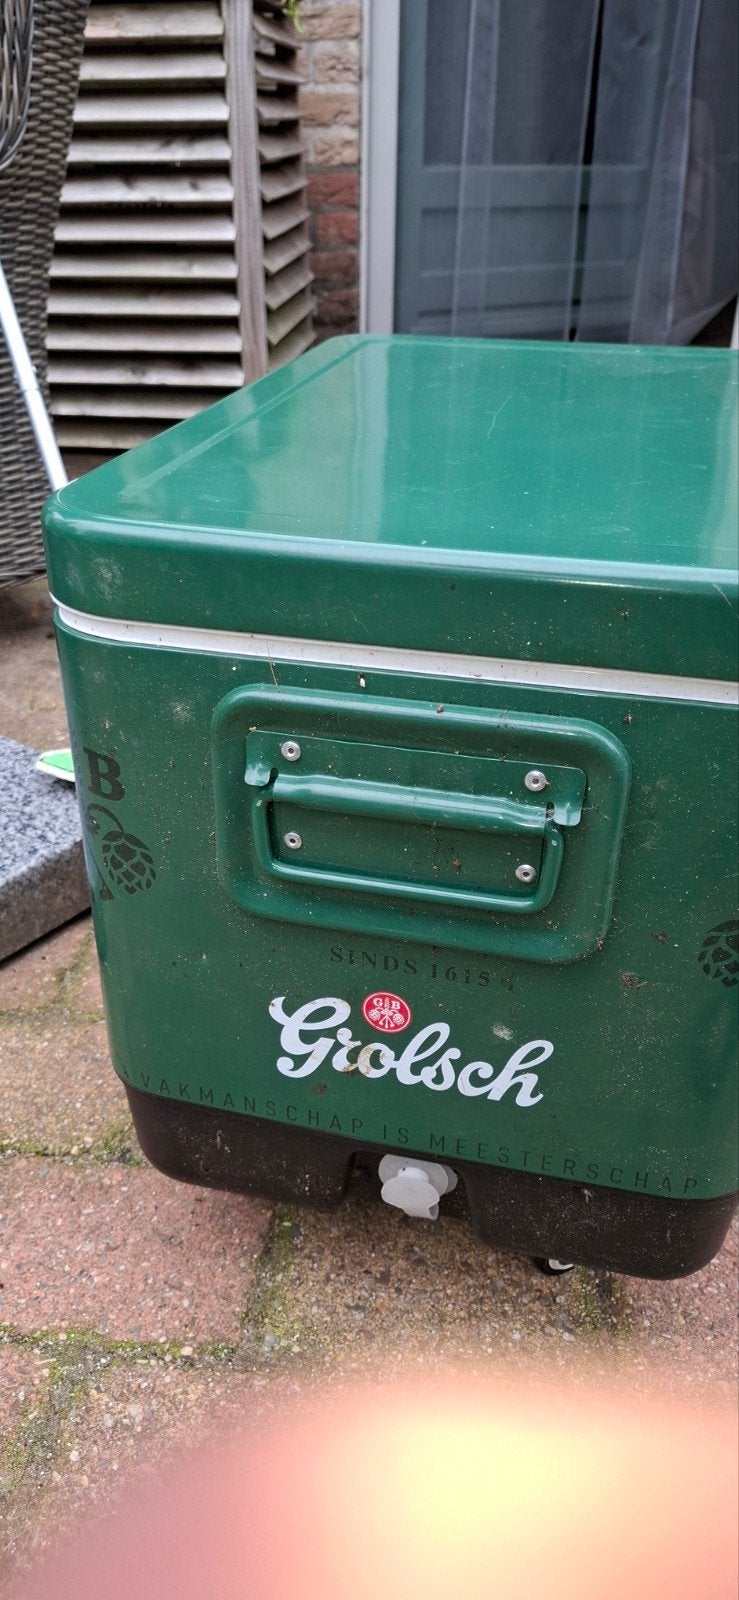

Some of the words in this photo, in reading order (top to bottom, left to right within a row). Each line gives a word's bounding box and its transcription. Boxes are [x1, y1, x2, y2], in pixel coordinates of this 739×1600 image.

[83, 747, 126, 801] B
[329, 947, 418, 976] SINDS
[430, 963, 491, 987] 1615
[268, 996, 554, 1107] Grolsch
[139, 1071, 364, 1134] VAKMANSCHAP
[382, 1123, 410, 1145] IS
[428, 1132, 699, 1195] MEESTERSCHAP
